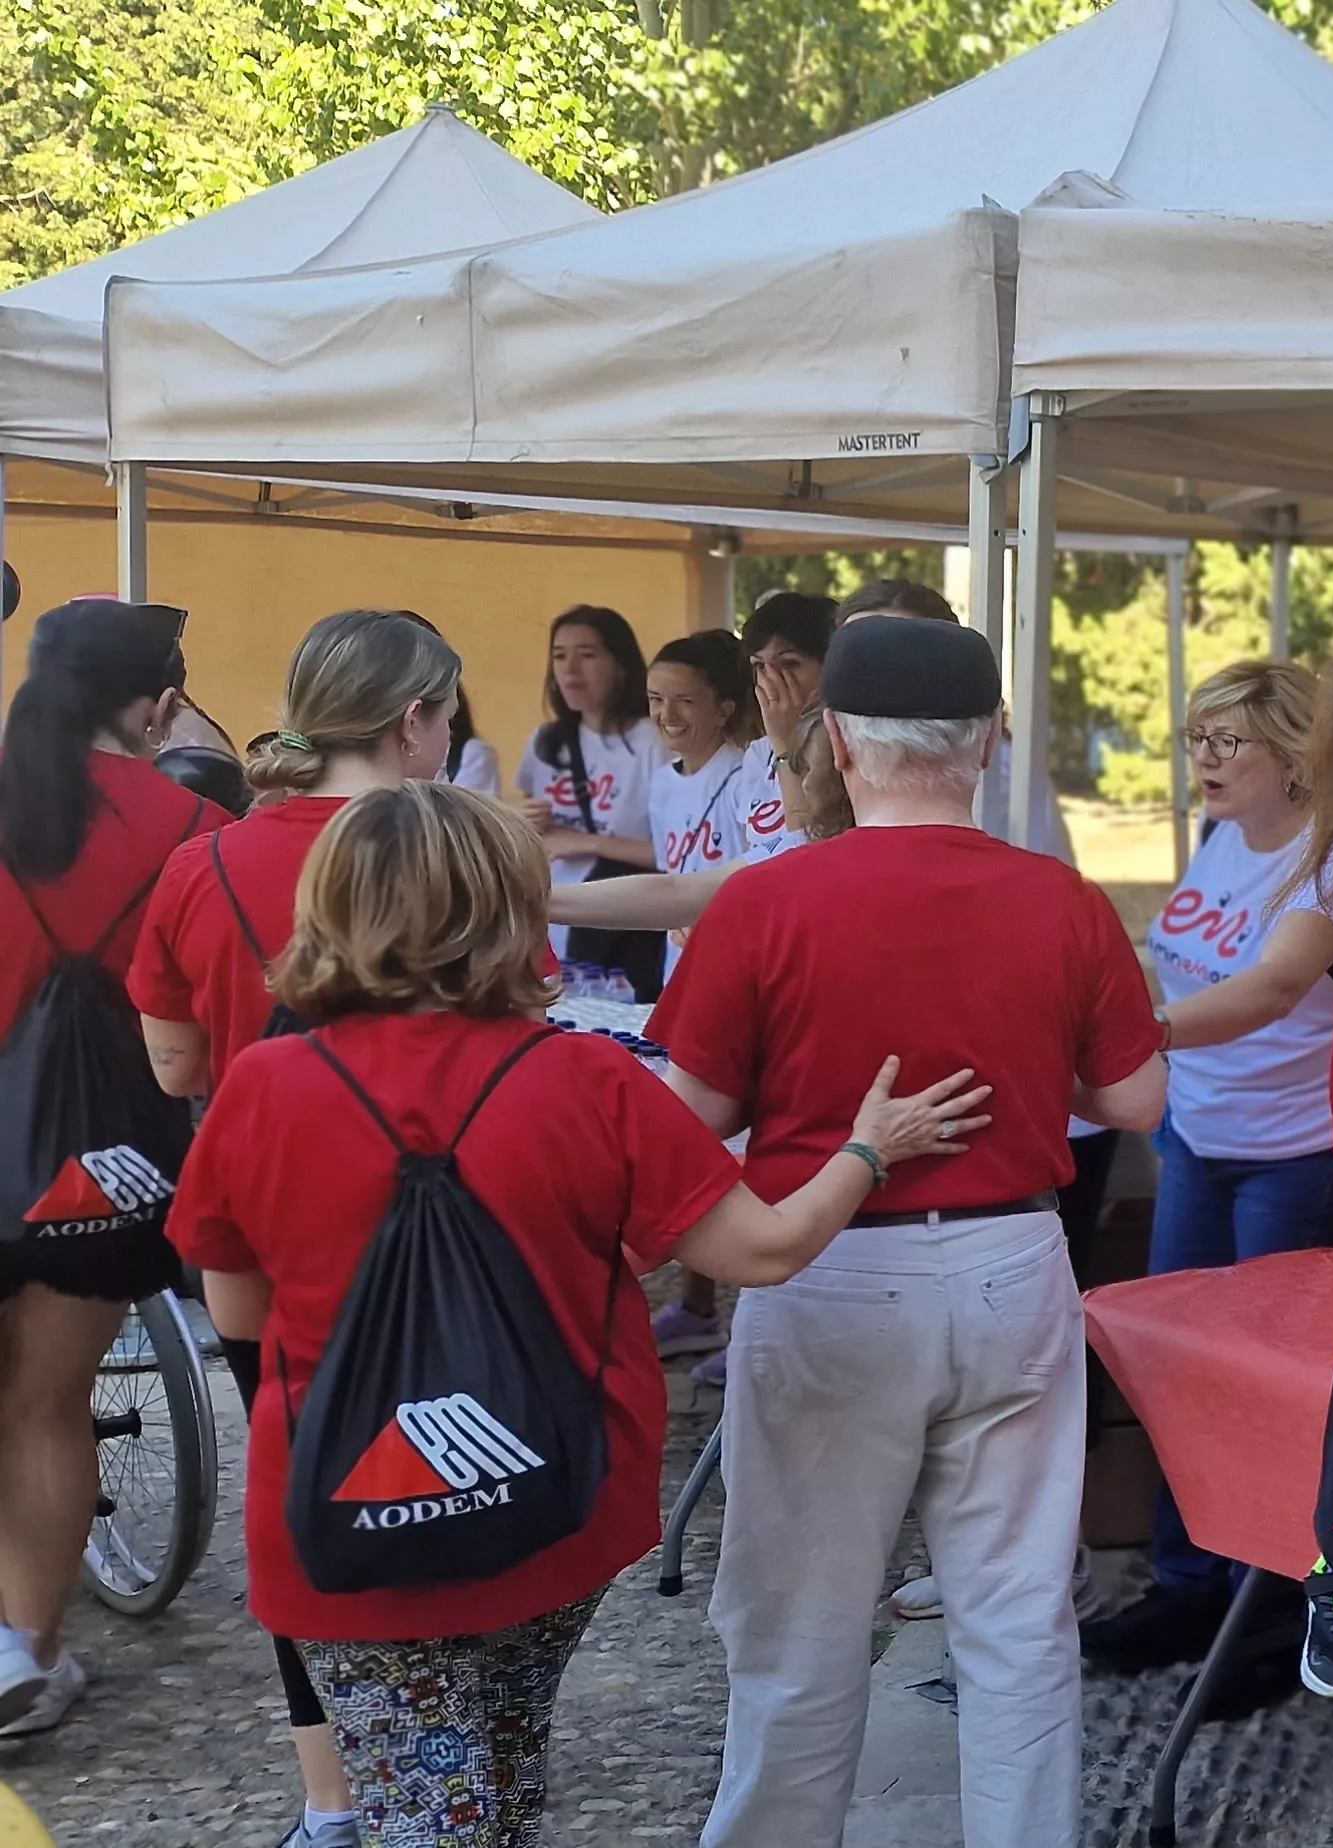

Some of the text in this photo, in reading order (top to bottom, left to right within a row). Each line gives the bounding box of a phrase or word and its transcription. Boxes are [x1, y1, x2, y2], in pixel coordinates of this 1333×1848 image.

[838, 431, 921, 452] MASTERTENT
[37, 1207, 156, 1238] AODEM
[351, 1483, 513, 1530] AODEM
